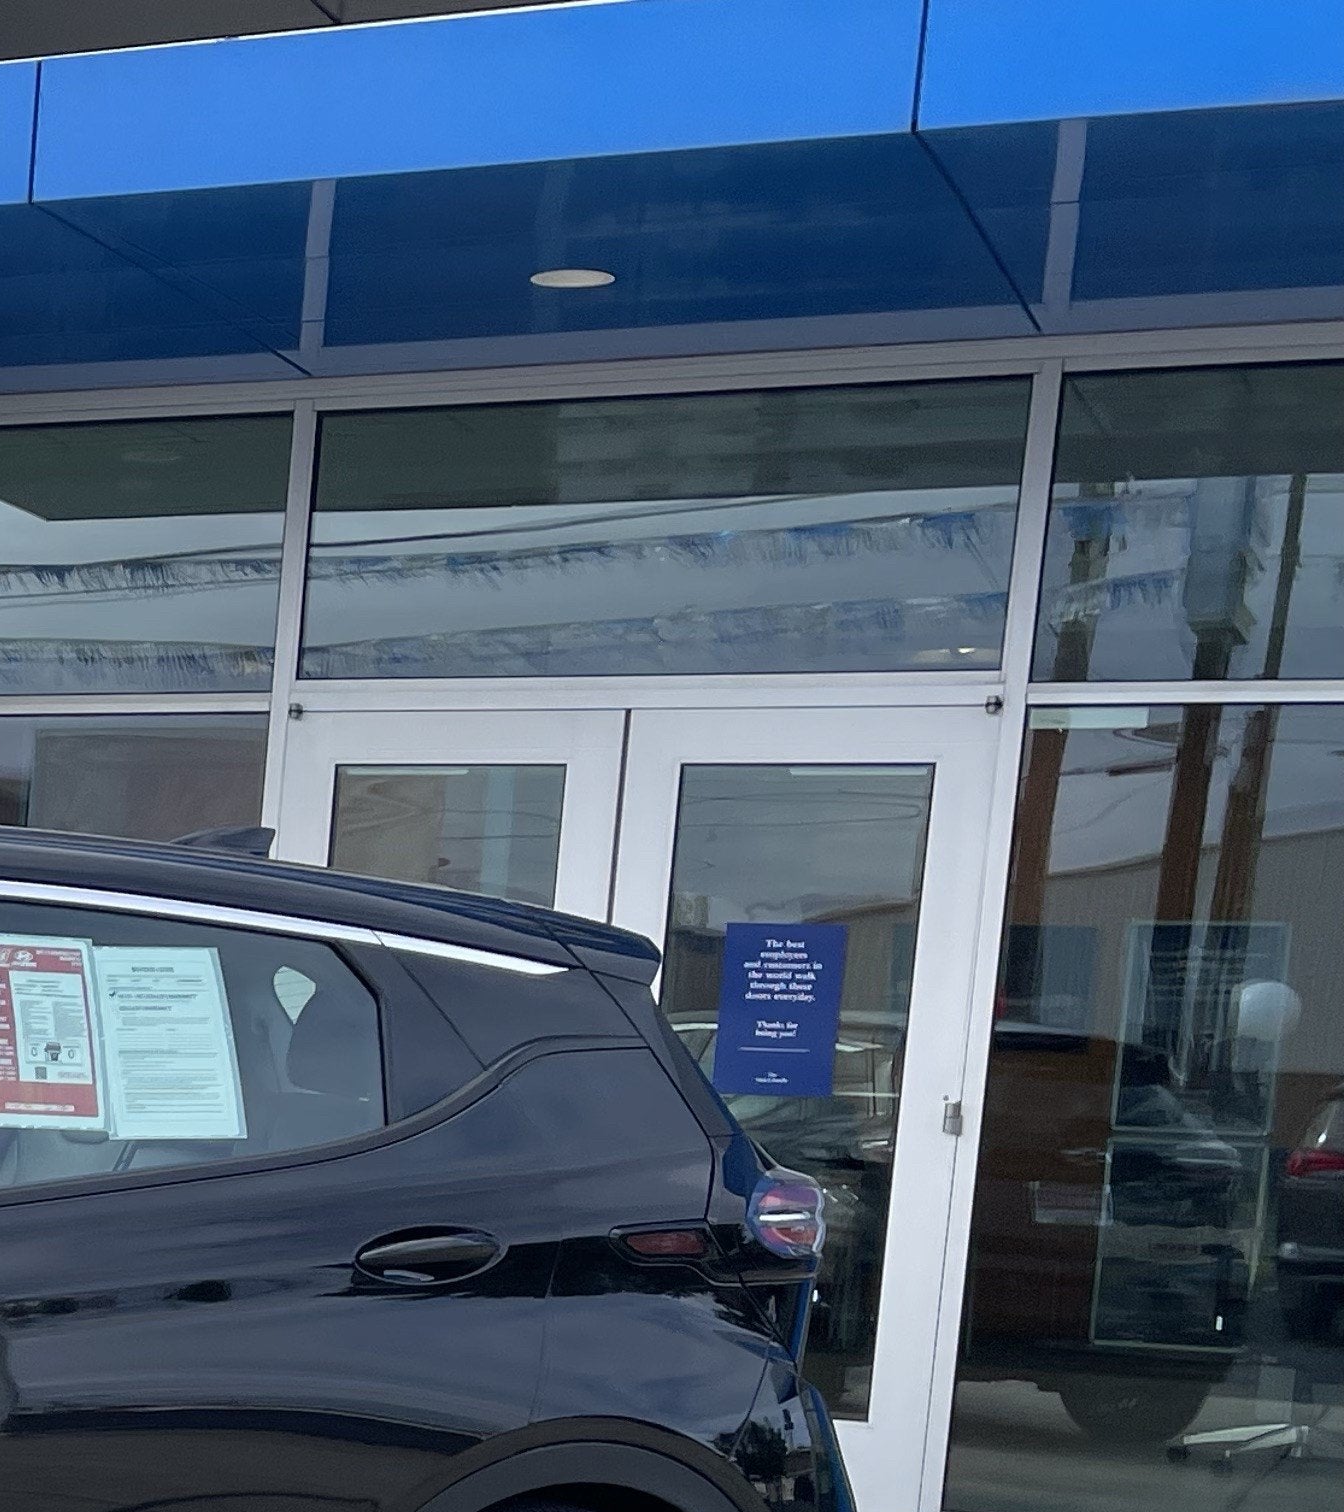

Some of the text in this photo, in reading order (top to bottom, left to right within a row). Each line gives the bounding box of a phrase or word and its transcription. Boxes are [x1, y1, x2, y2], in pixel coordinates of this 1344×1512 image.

[765, 939, 805, 948] The best
[743, 960, 761, 969] and
[813, 961, 823, 970] in
[748, 970, 816, 980] the world walk
[749, 981, 787, 991] through
[744, 991, 772, 1000] doors
[756, 1020, 799, 1030] Thanks for
